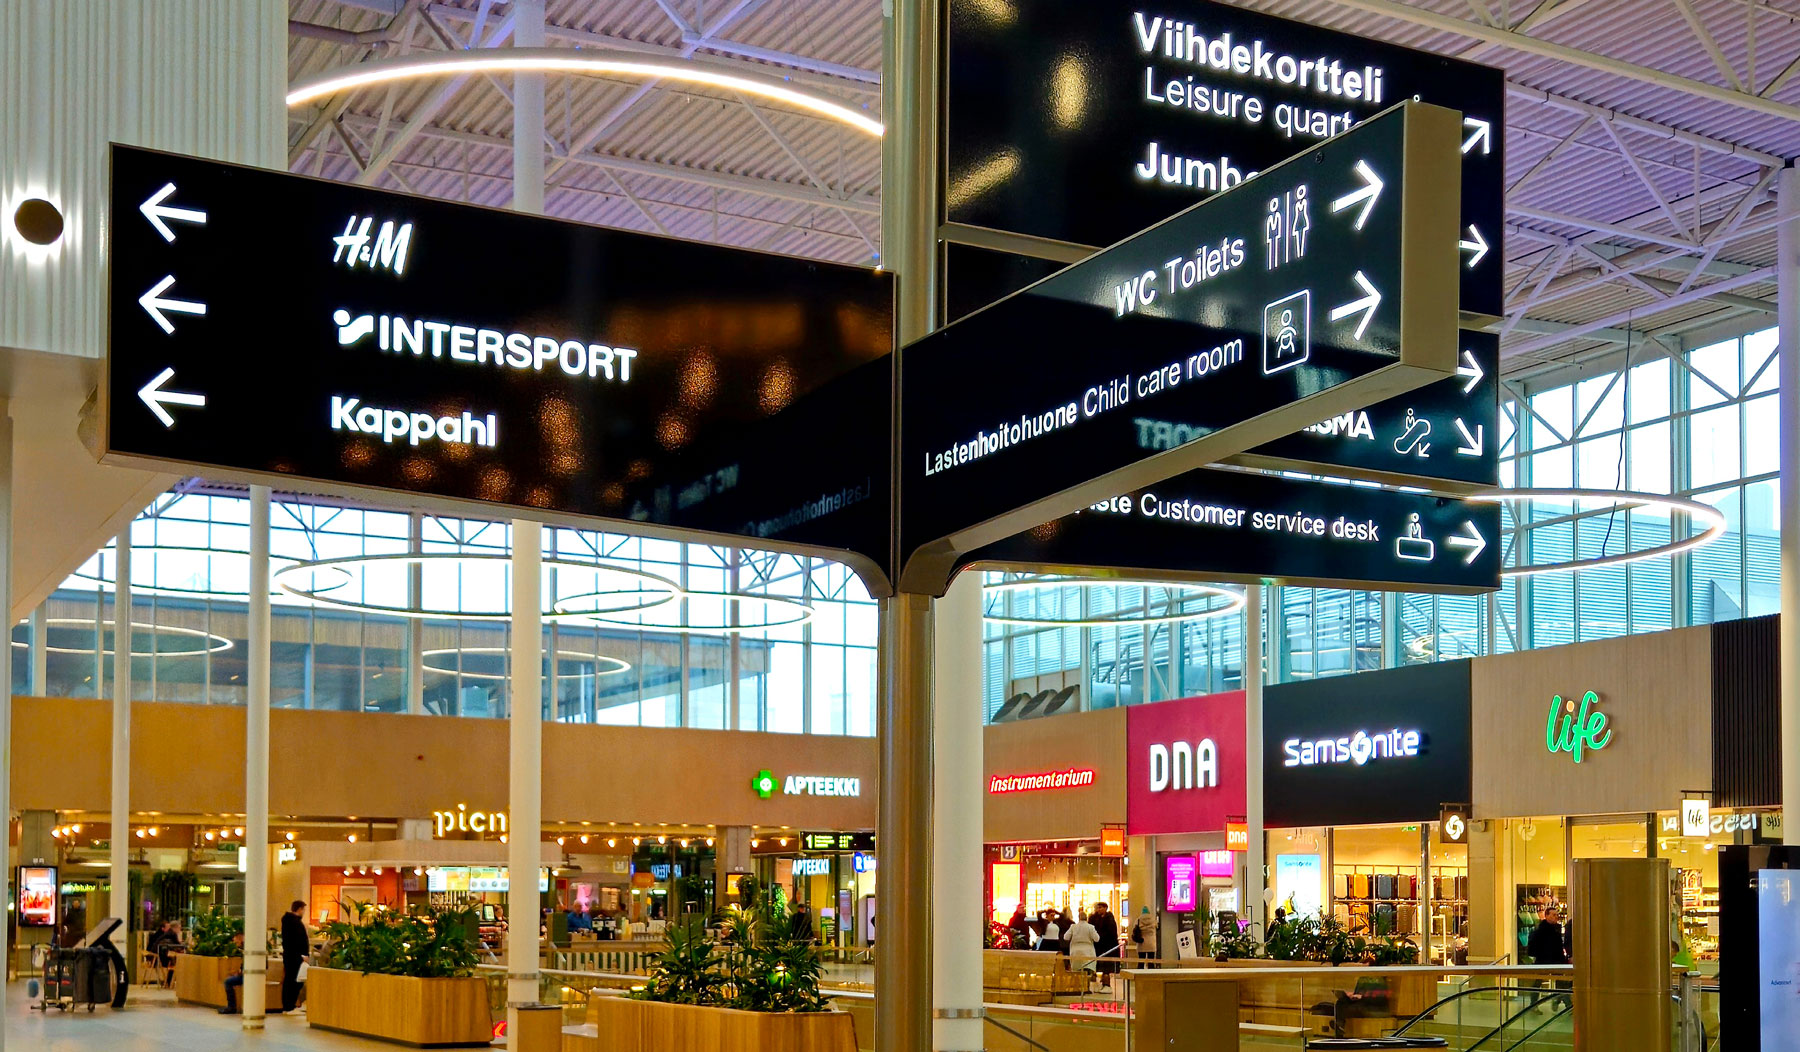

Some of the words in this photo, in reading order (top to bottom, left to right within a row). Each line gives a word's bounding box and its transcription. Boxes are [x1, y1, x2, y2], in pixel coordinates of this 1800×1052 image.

[1133, 11, 1383, 103] Viihdekortteli
[1146, 66, 1263, 123] Leisure
[1274, 103, 1365, 138] quart
[1136, 142, 1261, 192] Jumb
[332, 214, 413, 275] H&M
[1114, 270, 1157, 317] WC
[1165, 237, 1244, 294] Toilets
[378, 315, 638, 382] INTERSPORT
[331, 396, 496, 447] Kappahl
[925, 402, 1077, 477] Lastenhoitohuone
[1083, 374, 1130, 417] Child
[1137, 361, 1181, 398] care
[1187, 338, 1243, 379] room
[1140, 493, 1246, 527] Customer
[1252, 511, 1326, 536] service
[1332, 516, 1379, 542] desk
[1284, 729, 1421, 766] Samsonite
[1547, 690, 1612, 763] life
[783, 775, 860, 796] APTEEKKI
[990, 768, 1093, 793] instrumentarium
[1150, 738, 1217, 792] DNA
[1228, 831, 1247, 843] DNA
[1687, 809, 1704, 828] life
[792, 859, 829, 875] APTEEKKI
